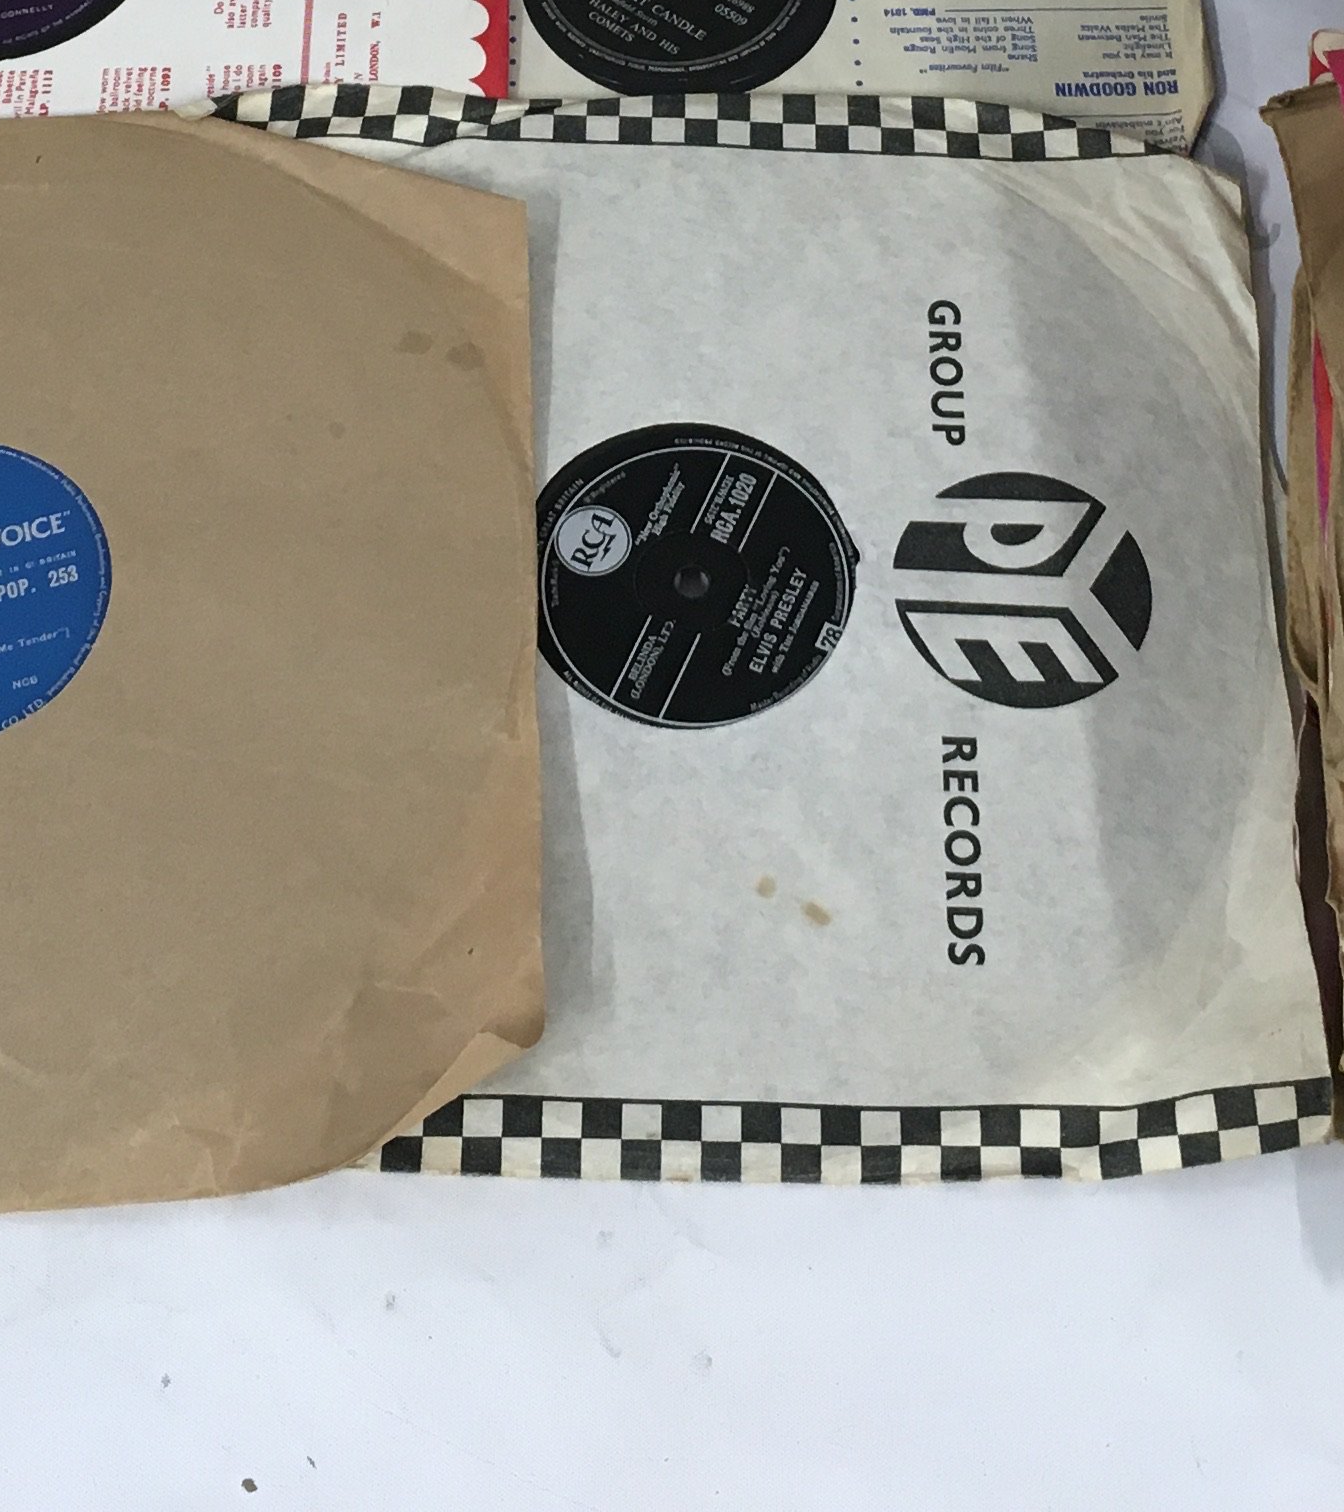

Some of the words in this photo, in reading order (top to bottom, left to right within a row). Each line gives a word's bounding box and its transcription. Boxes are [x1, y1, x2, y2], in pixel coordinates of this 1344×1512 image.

[588, 11, 636, 42] COMETS
[652, 0, 707, 41] CANDLE
[714, 3, 748, 27] 05509
[630, 20, 658, 41] AND
[659, 37, 681, 55] HIS
[1055, 82, 1137, 97] GOODWIN
[1144, 80, 1179, 95] RON
[926, 300, 966, 446] GROUP
[709, 472, 757, 544] RCA.1020
[571, 513, 616, 569] RCA
[47, 565, 79, 588] 253
[749, 632, 777, 674] ELVIS
[770, 568, 807, 629] PRESLEY
[817, 625, 842, 650] 78
[940, 734, 986, 966] RECORDS
